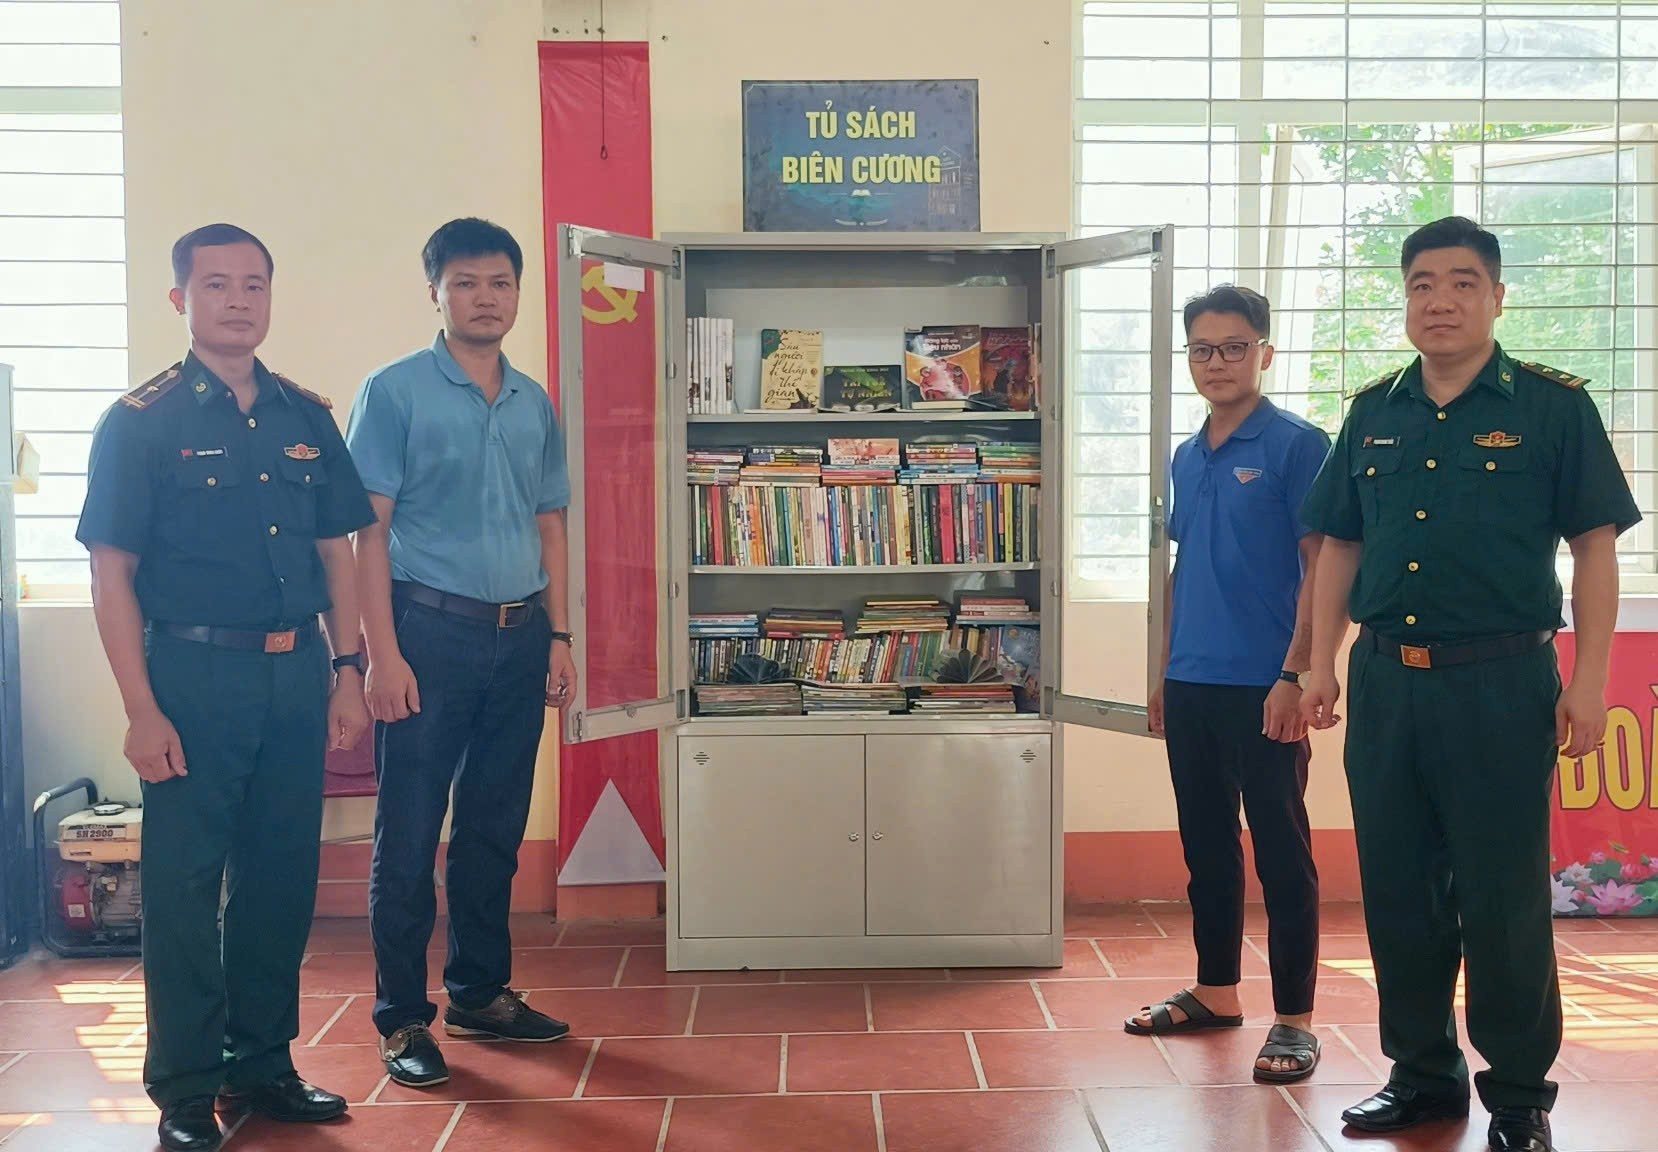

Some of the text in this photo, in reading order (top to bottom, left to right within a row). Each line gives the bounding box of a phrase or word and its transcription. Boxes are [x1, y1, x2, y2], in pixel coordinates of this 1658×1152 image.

[805, 100, 916, 139] TỦ SÁCH
[782, 151, 941, 184] BIÊN CƯƠNG
